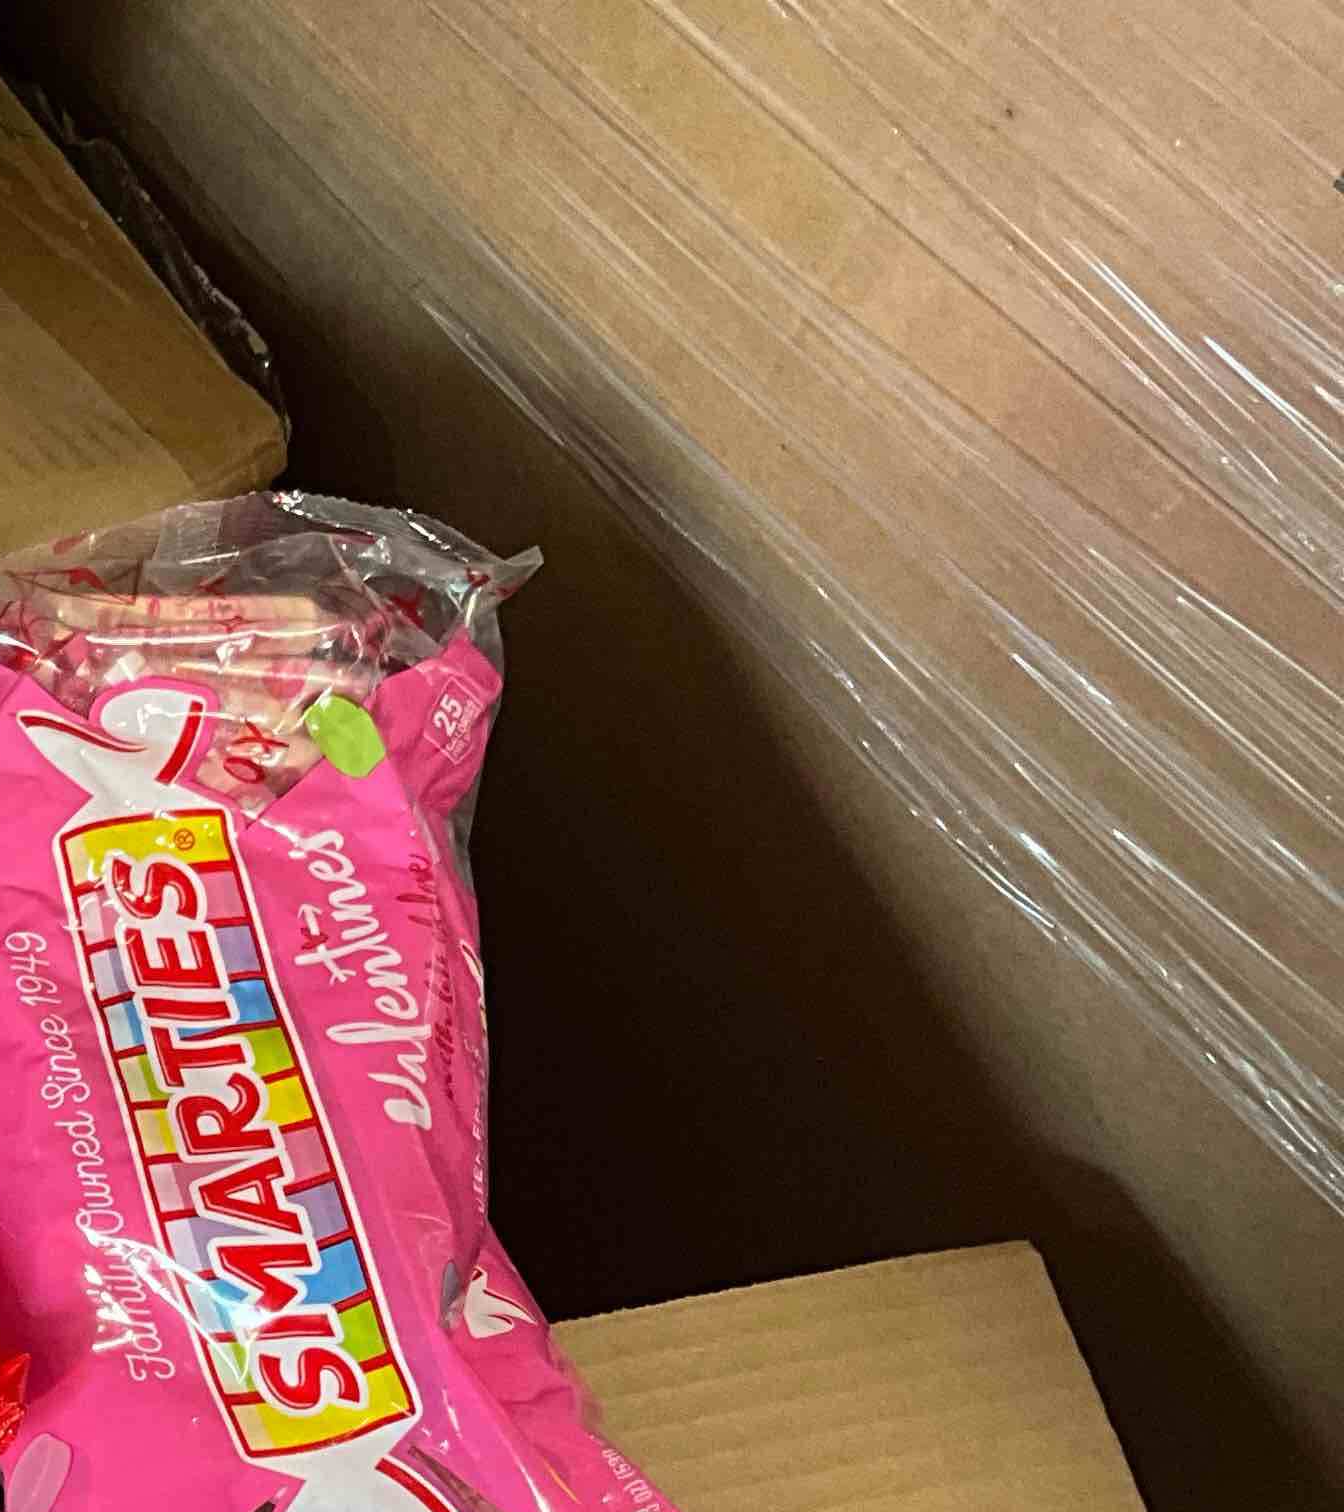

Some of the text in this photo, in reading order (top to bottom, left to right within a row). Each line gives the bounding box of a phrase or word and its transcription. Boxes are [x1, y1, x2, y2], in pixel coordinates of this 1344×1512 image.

[433, 693, 464, 738] 25
[4, 930, 62, 1007] 1949
[40, 1013, 91, 1110] Since
[54, 1112, 125, 1243] Owned
[106, 850, 368, 1415] SMARTIES
